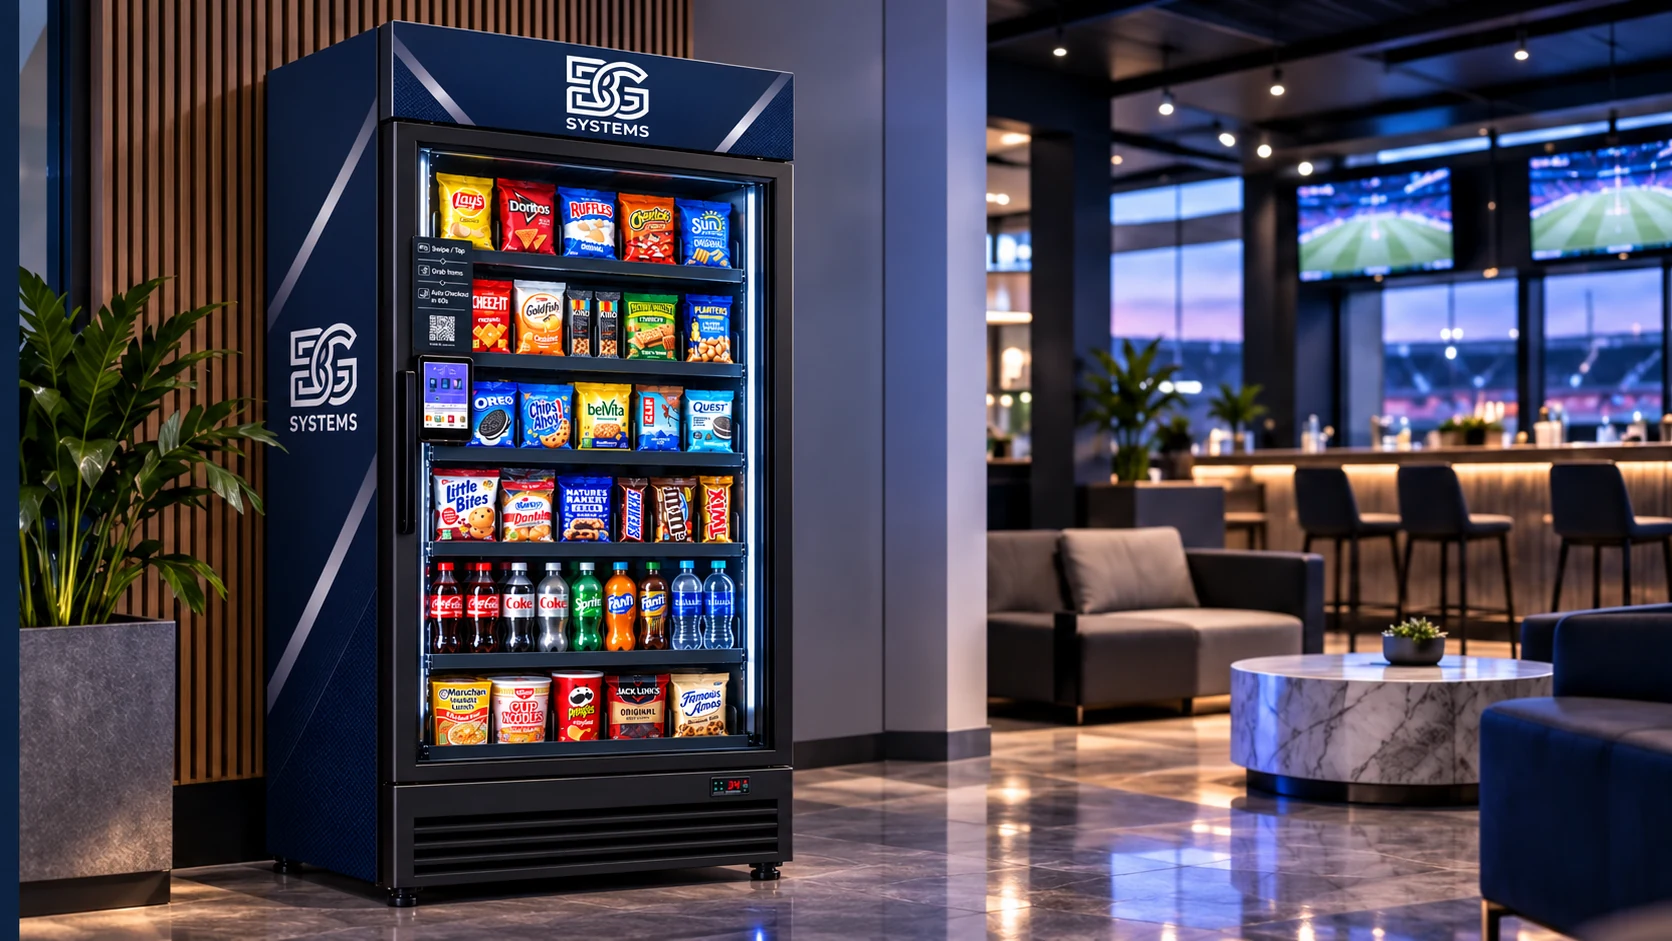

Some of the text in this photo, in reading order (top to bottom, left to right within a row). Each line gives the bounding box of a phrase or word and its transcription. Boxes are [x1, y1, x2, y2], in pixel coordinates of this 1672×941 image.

[566, 117, 650, 138] SYSTEMS
[454, 192, 483, 210] Lay's
[509, 200, 550, 215] Doritos
[569, 202, 614, 219] RUFFLES
[692, 217, 718, 234] Sun
[526, 302, 560, 317] Goldfish
[474, 396, 514, 410] OREO
[588, 399, 625, 416] belVita
[693, 402, 725, 413] QUEST
[289, 412, 358, 432] SYSTEMS
[446, 479, 478, 504] Little
[456, 494, 488, 513] Bites
[505, 597, 533, 609] Coke
[540, 596, 568, 609] Coke
[511, 701, 538, 713] CUP
[502, 711, 543, 724] NOODLES
